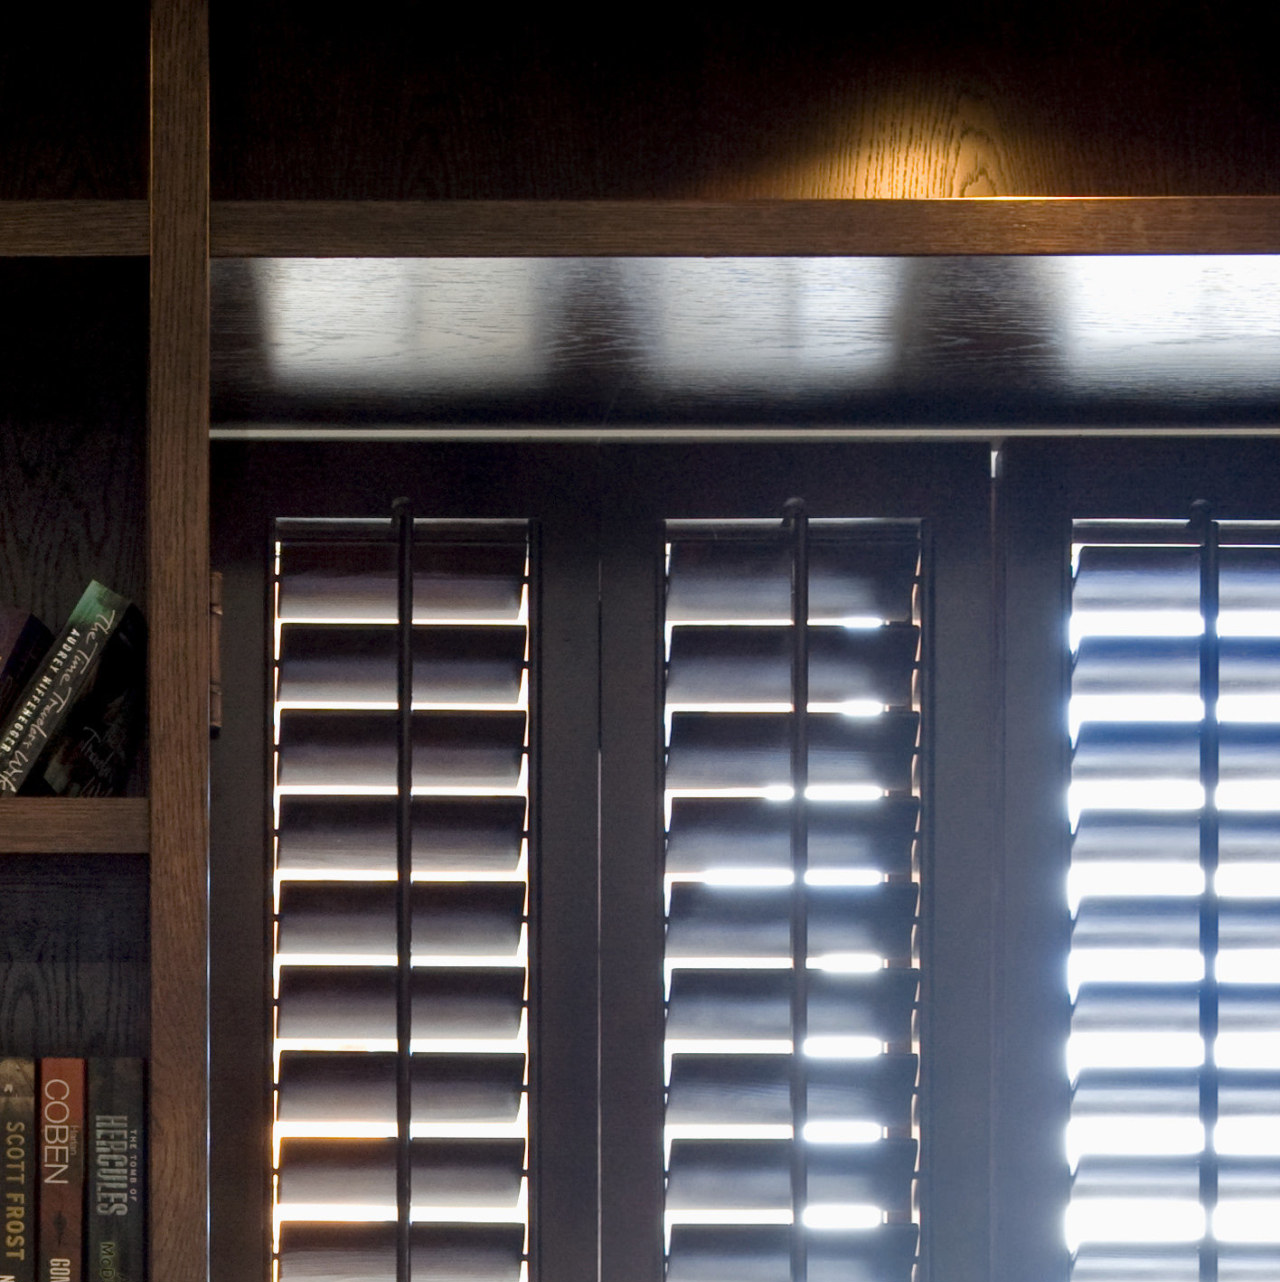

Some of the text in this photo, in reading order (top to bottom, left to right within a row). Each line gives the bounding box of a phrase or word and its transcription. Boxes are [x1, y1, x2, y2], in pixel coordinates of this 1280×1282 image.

[44, 1079, 70, 1185] COBEN
[95, 1115, 128, 1217] HERCULES
[5, 1121, 25, 1261] SCOTT FROST
